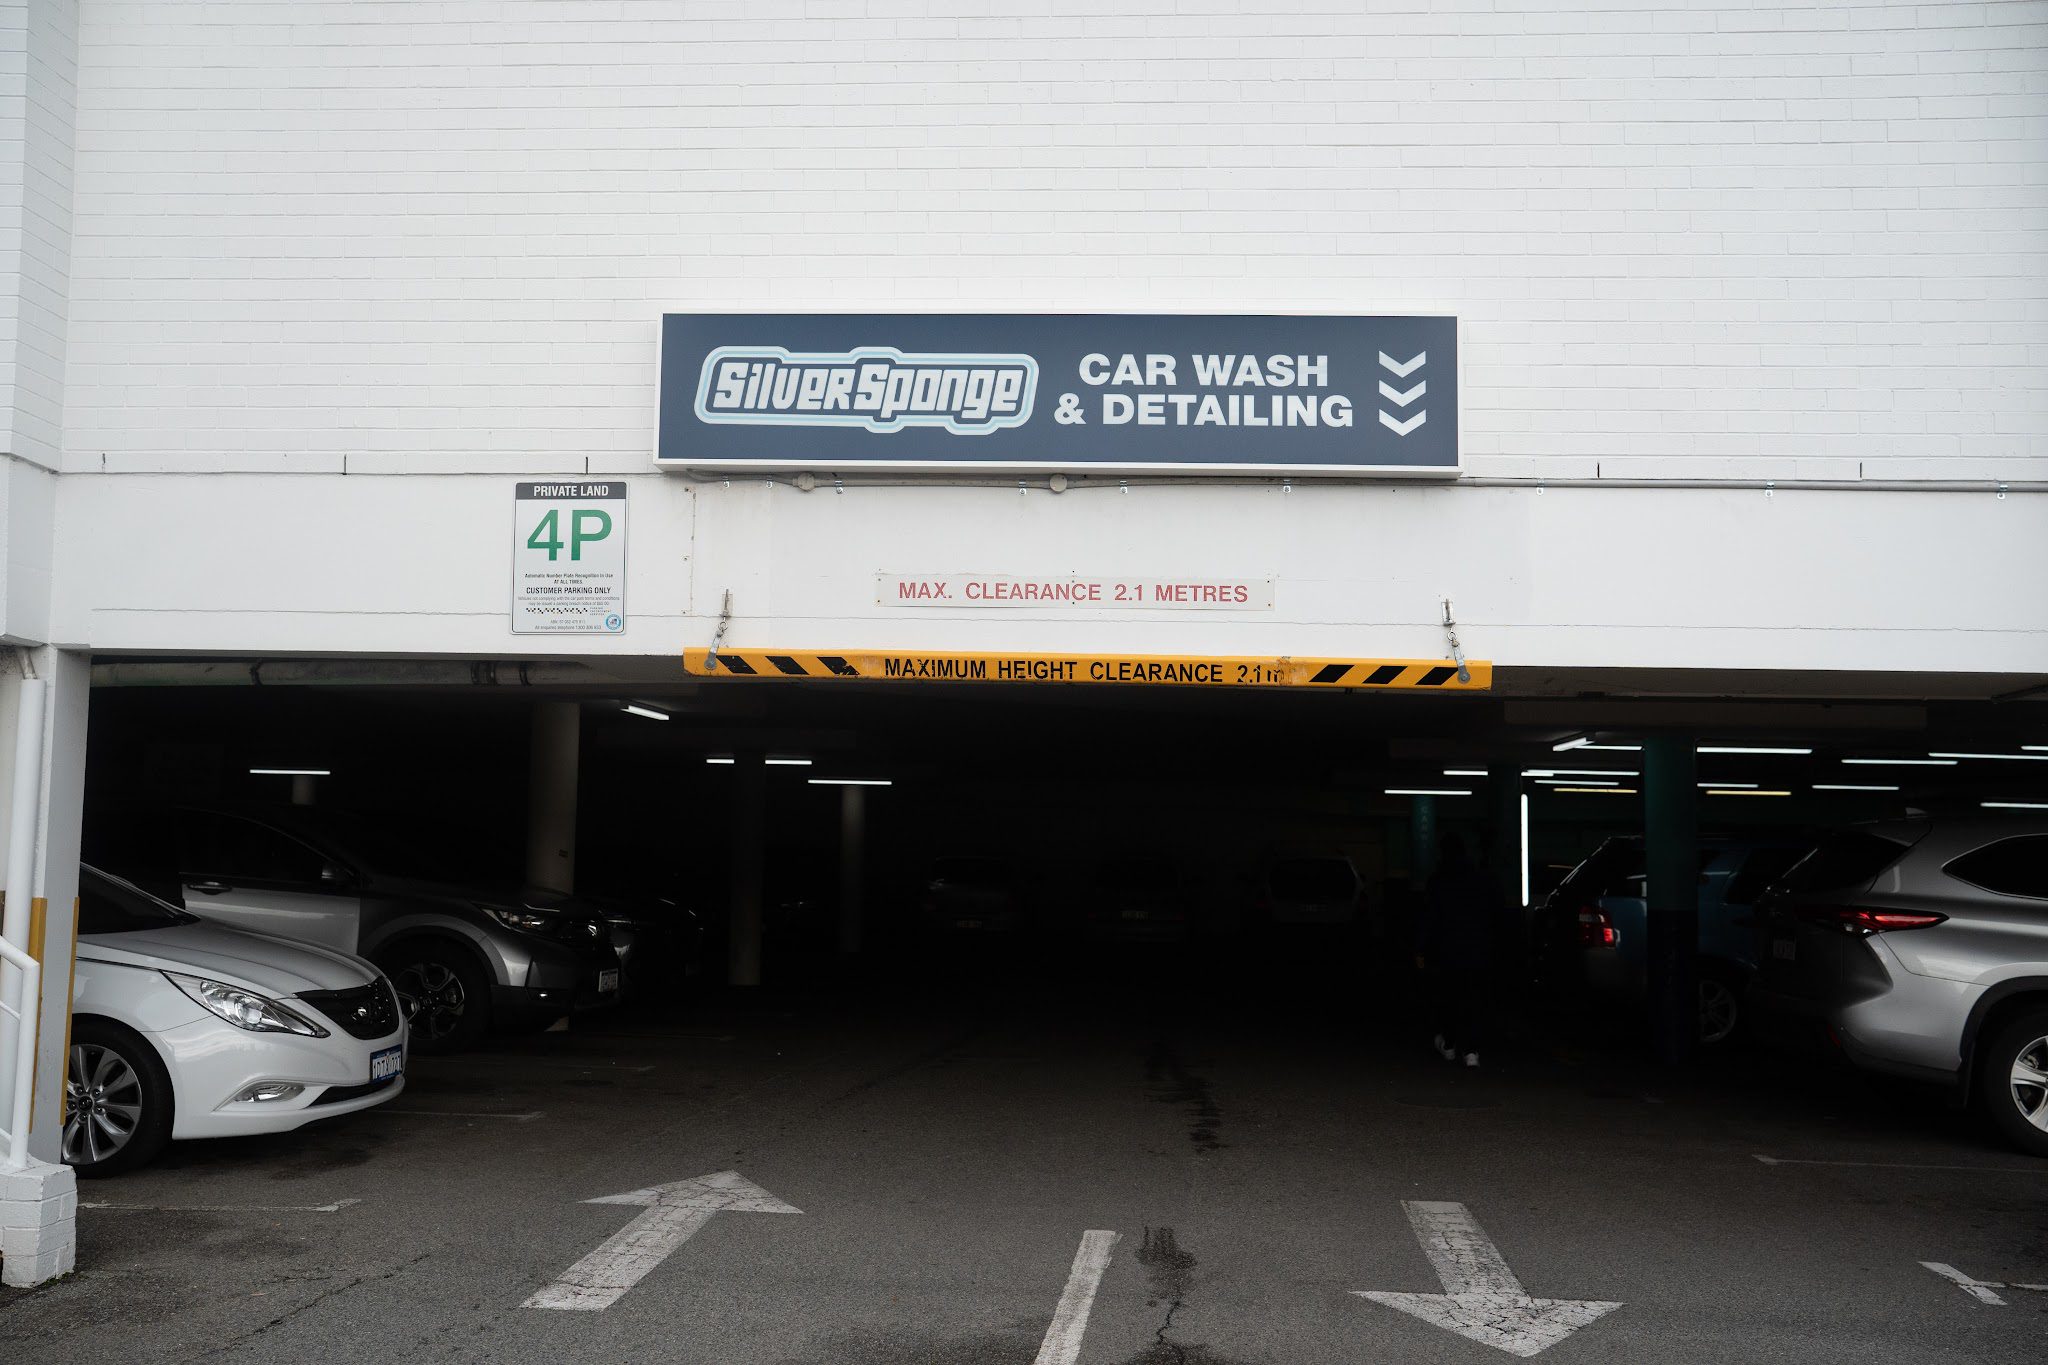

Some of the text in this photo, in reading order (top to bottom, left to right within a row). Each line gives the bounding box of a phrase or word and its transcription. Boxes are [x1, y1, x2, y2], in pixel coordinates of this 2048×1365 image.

[1078, 352, 1328, 388] CAR WASH
[1053, 392, 1353, 428] & DETAILING
[533, 485, 609, 497] PRIVATE LAND
[527, 508, 613, 562] 4P
[526, 586, 611, 595] CUSTOMER PARKING ONLY
[898, 580, 1249, 605] MAX. CLEARANCE 2.1 METRES
[884, 657, 987, 682] MAXIMUM
[997, 660, 1078, 683] HEIGHT
[1089, 661, 1224, 684] CLEARANCE
